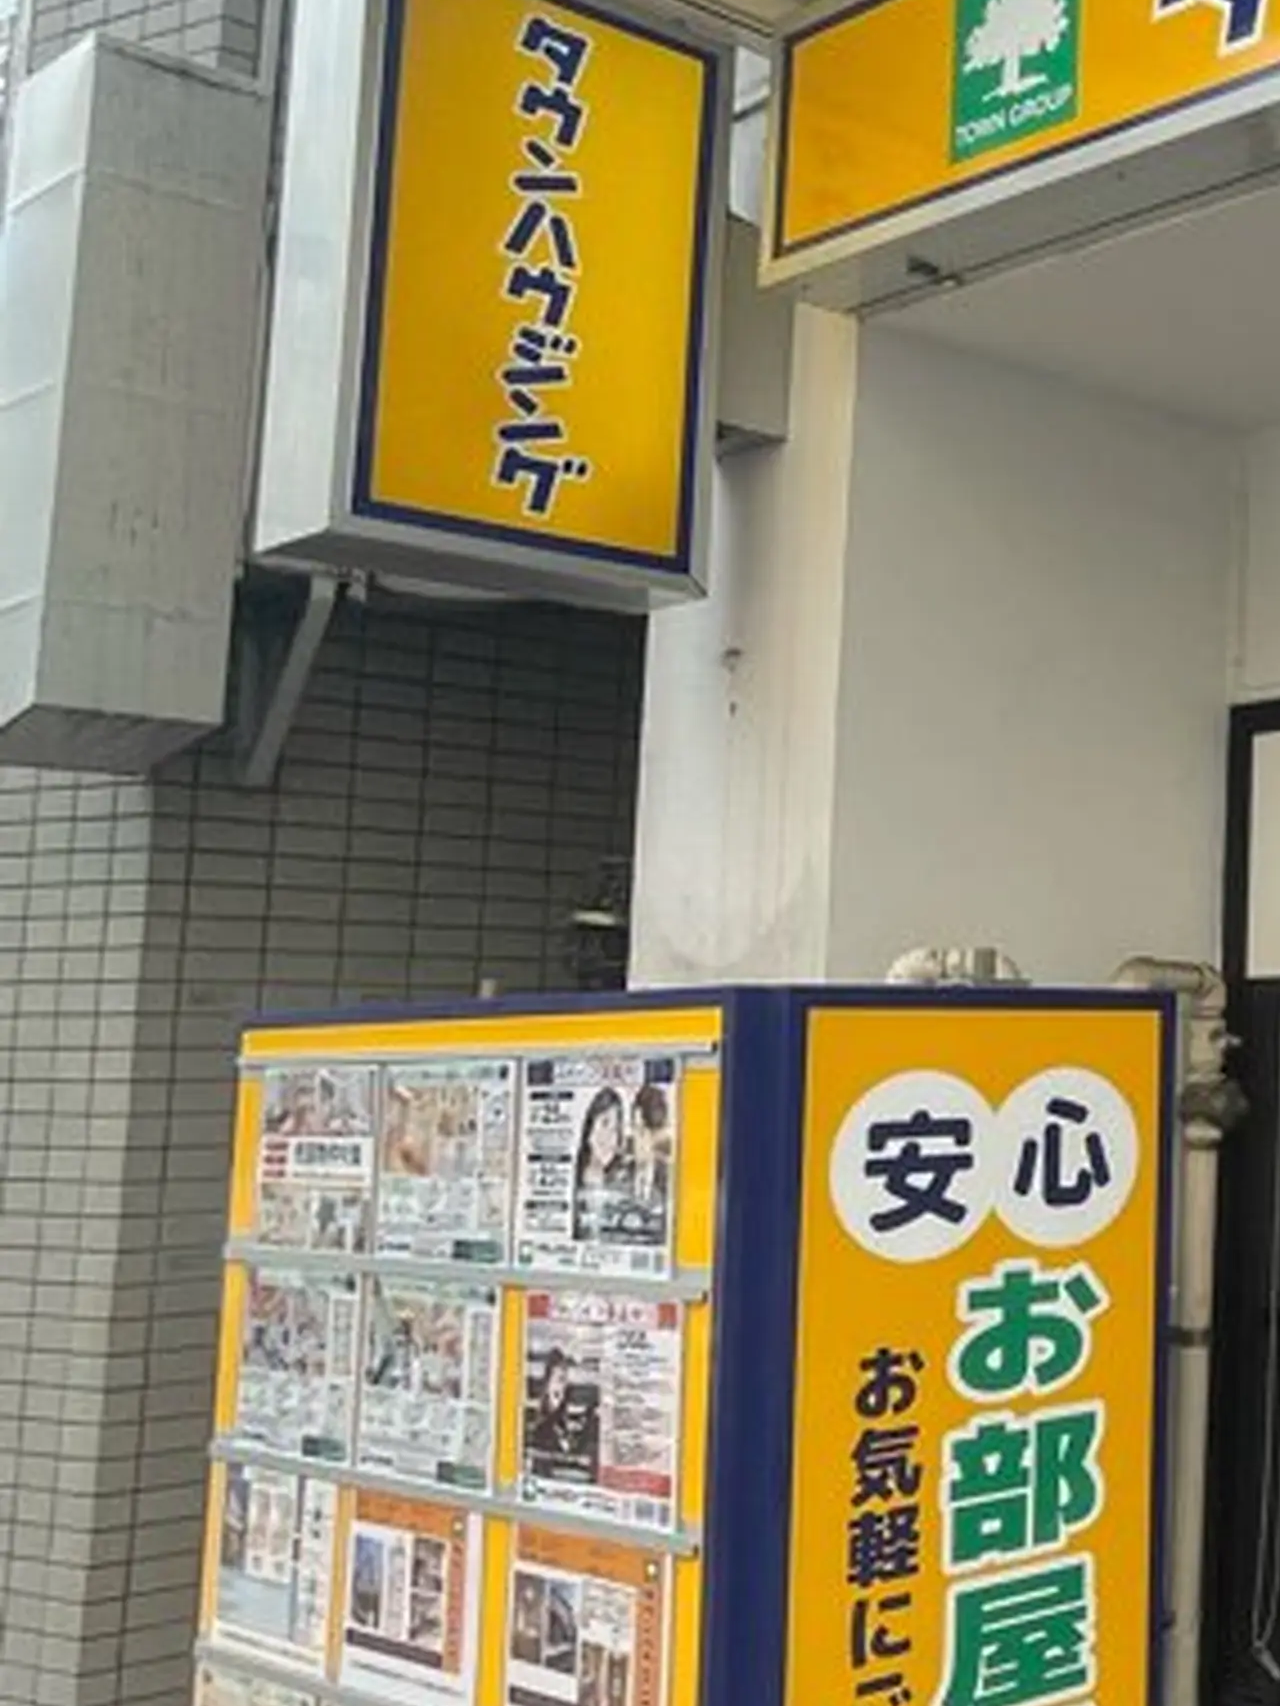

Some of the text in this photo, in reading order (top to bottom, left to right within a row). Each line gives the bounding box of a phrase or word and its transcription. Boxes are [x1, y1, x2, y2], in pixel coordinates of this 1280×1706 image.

[499, 16, 591, 516] タウンハウジング
[864, 1098, 1110, 1233] 安心
